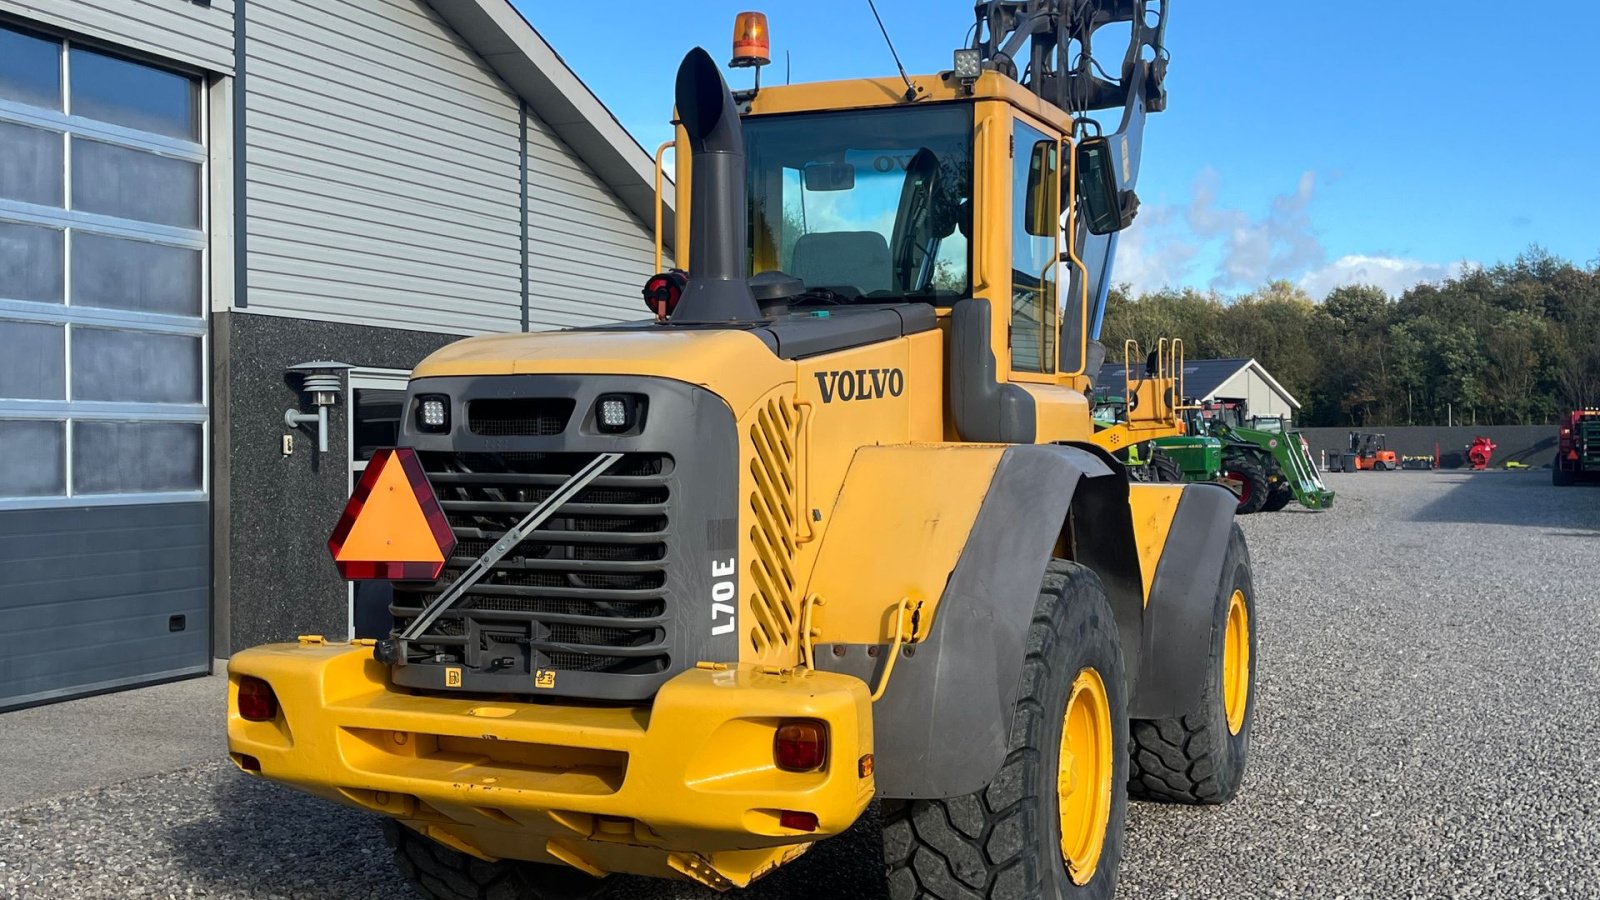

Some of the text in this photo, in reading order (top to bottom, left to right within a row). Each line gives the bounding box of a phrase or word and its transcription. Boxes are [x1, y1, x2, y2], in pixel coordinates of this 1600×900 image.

[814, 368, 904, 404] VOLVO
[711, 557, 735, 636] L70 E
